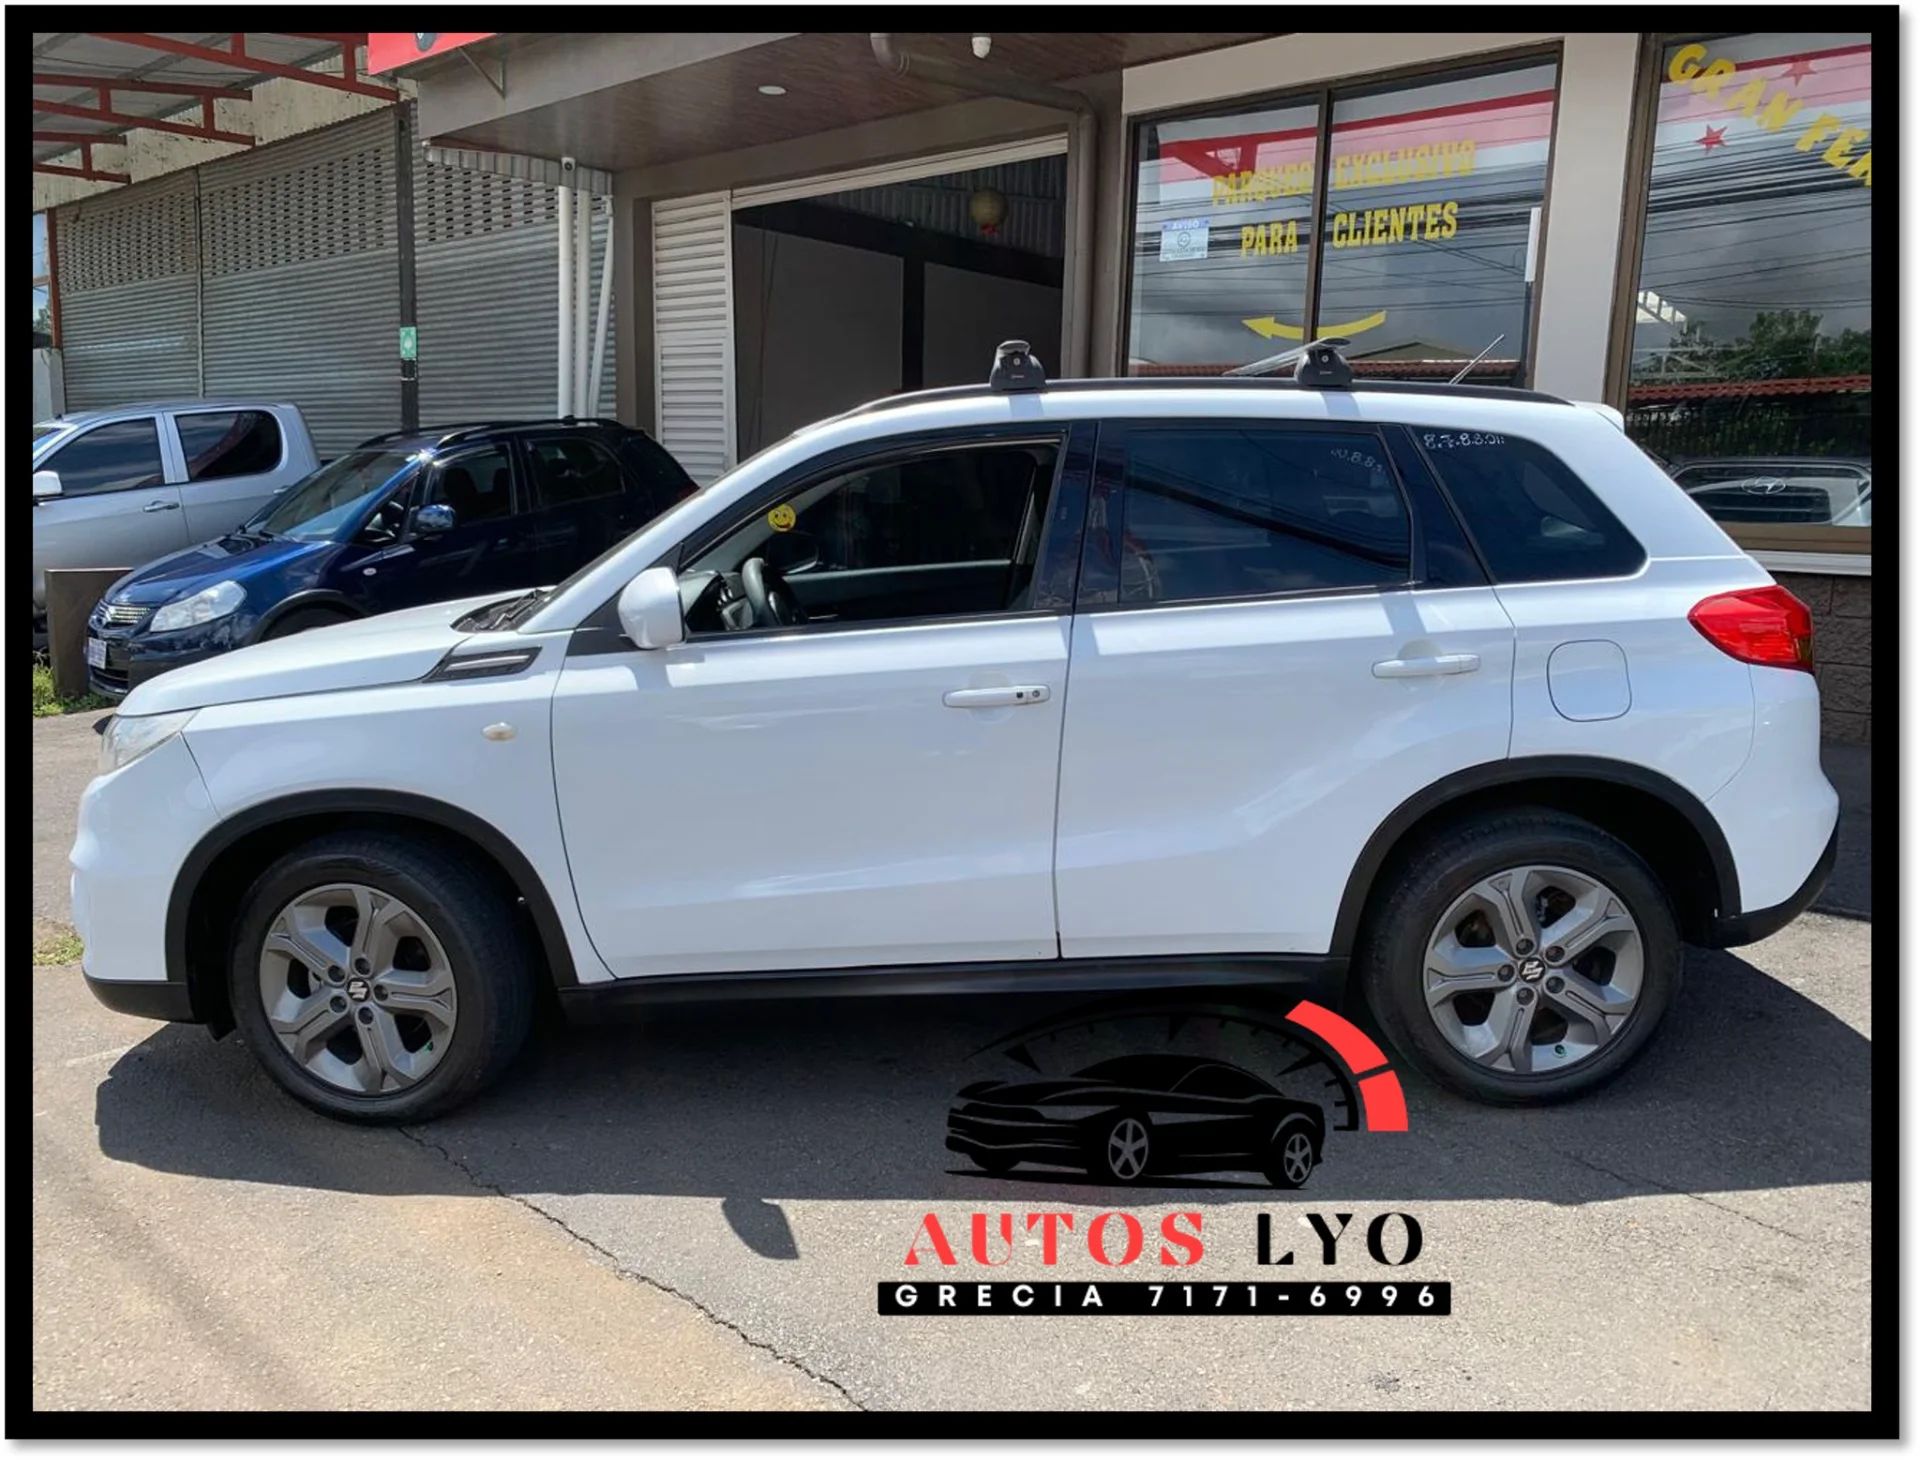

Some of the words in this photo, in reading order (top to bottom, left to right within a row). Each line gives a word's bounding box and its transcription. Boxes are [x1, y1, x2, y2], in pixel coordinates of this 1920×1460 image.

[1668, 43, 1803, 134] GRAN
[1334, 140, 1477, 191] EXCLUSIVO
[1240, 220, 1298, 258] PARA
[1333, 201, 1459, 249] CLIENTES
